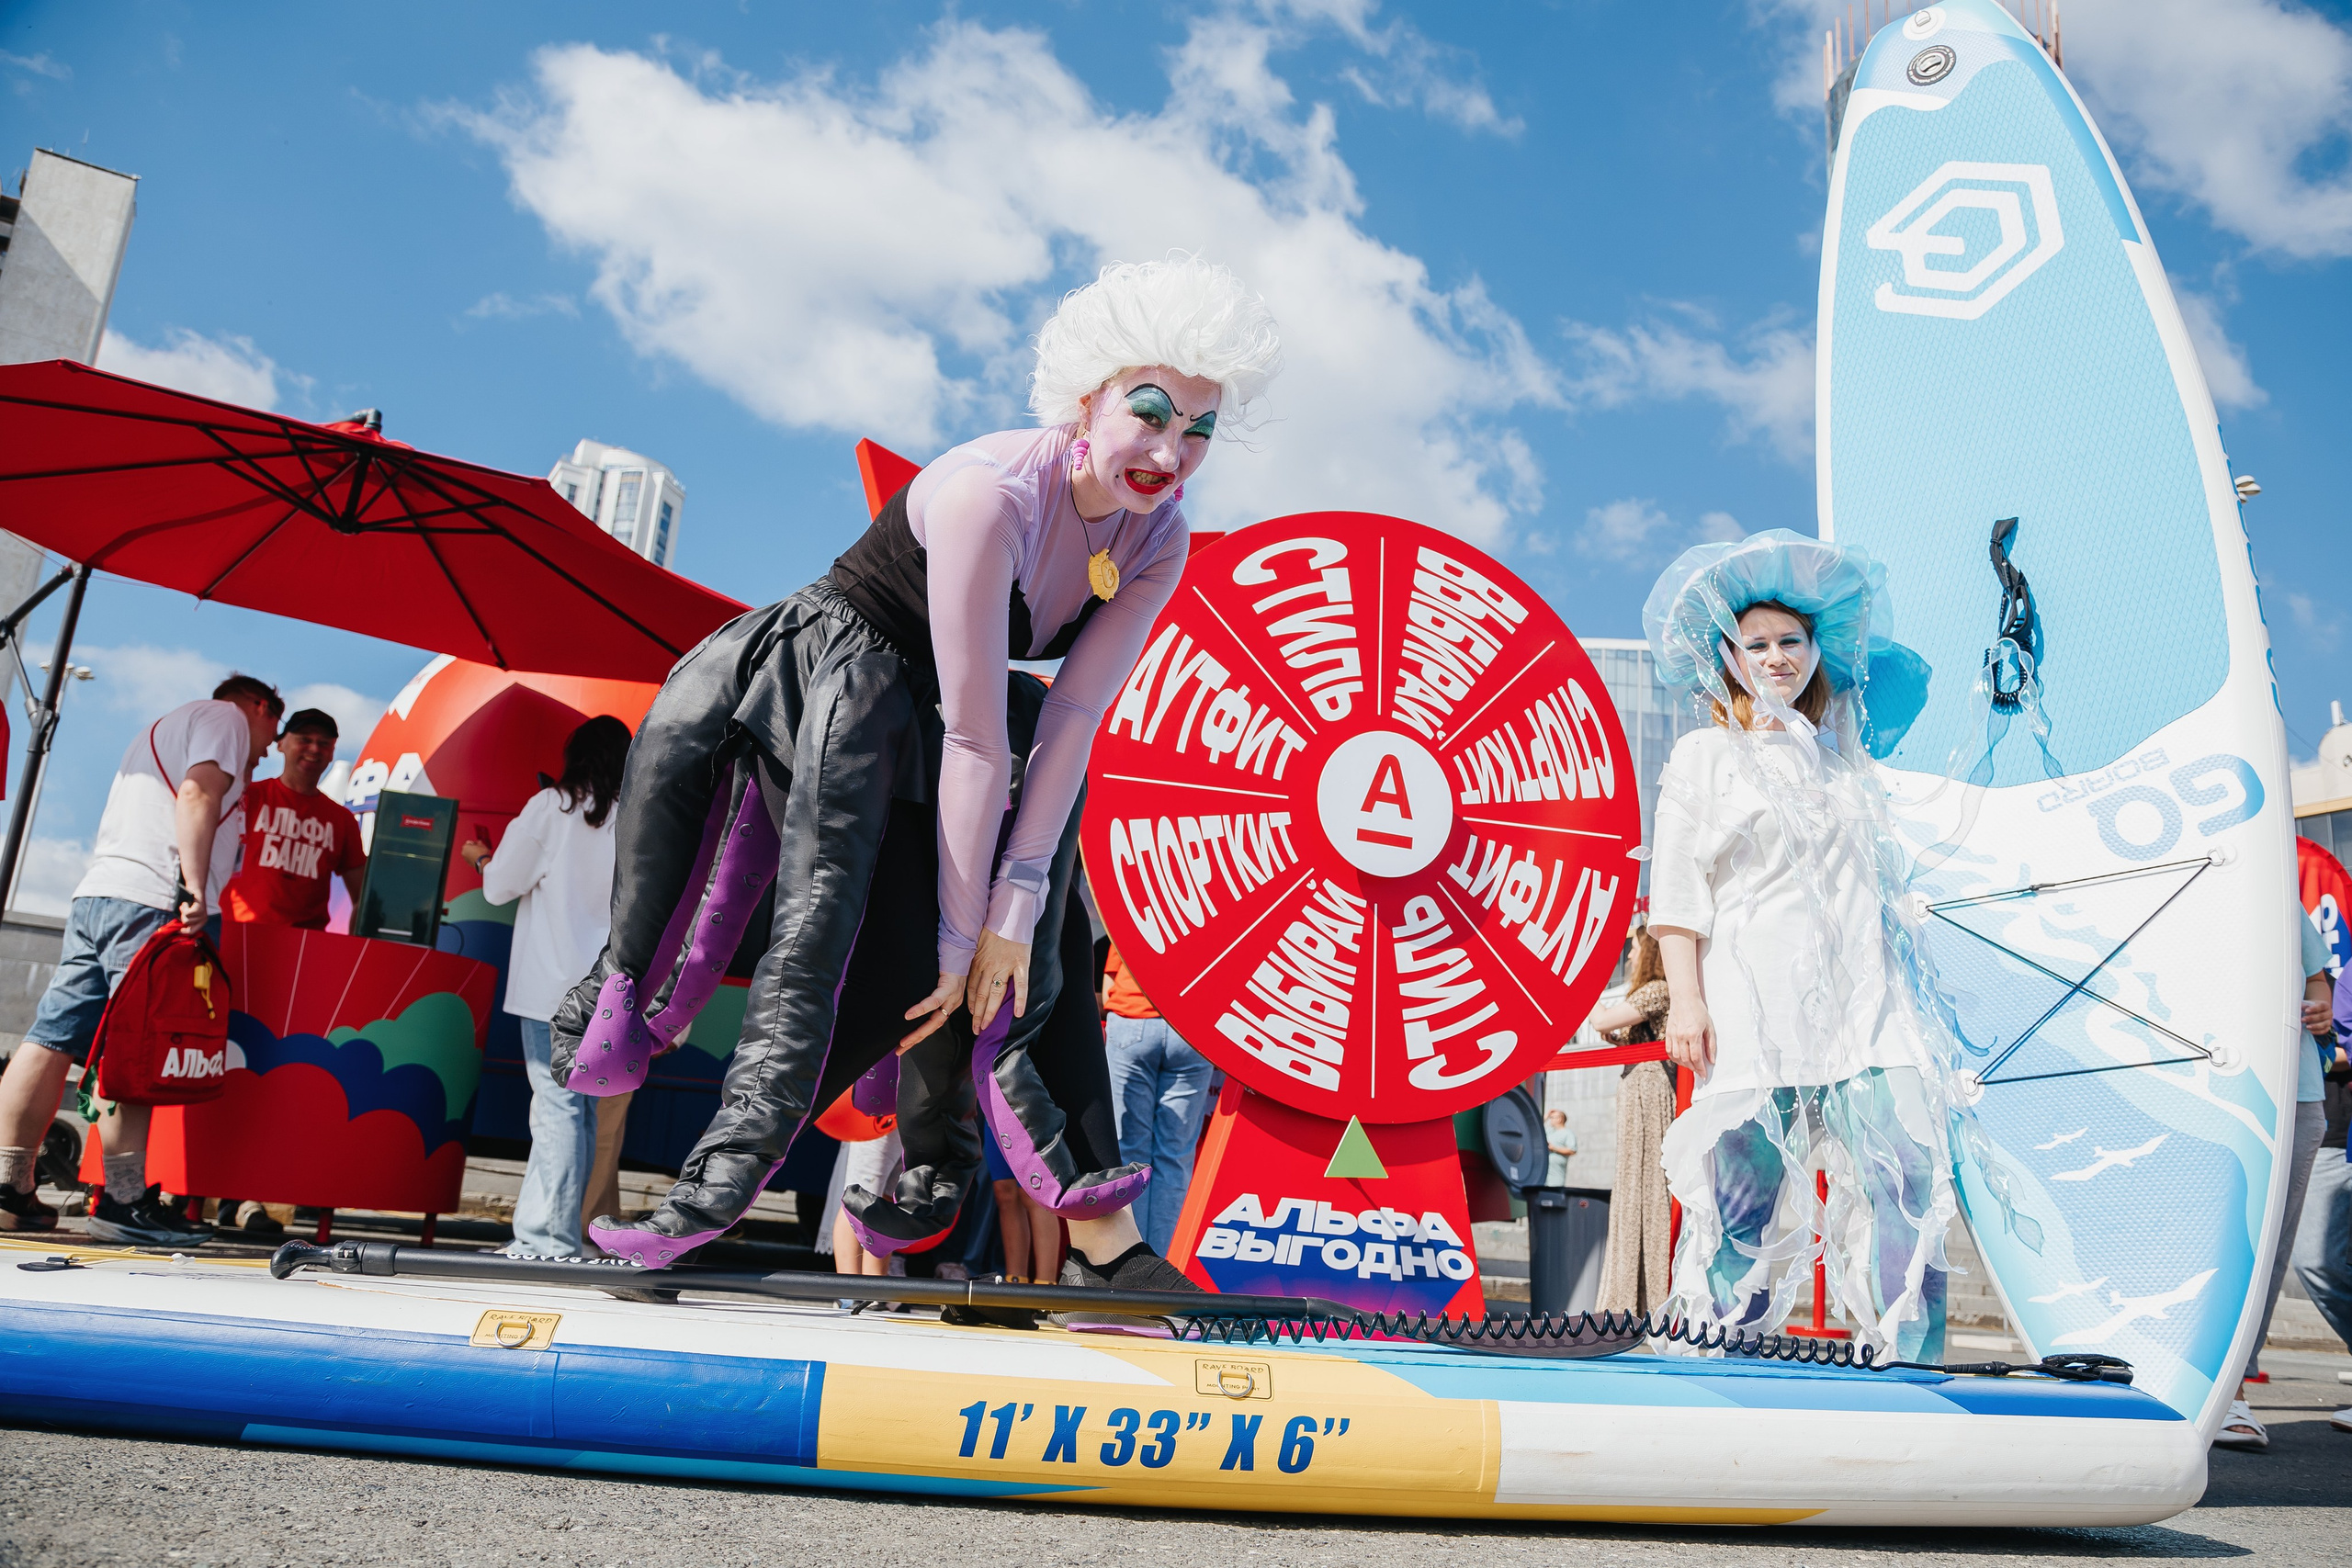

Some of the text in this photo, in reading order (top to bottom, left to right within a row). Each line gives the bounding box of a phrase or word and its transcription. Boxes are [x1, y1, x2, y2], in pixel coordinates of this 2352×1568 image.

[1232, 536, 1364, 722] СТИЛЬ
[1391, 545, 1530, 741] ВЫБИРАЙ
[1108, 622, 1307, 782] АУТФИТ
[1453, 677, 1615, 805] СПОРТКИТ
[253, 804, 334, 852] АЛЬФА
[2037, 747, 2170, 813] BOARD
[258, 834, 322, 880] БАНК
[1109, 811, 1299, 955] СПОРТКИТ
[1446, 834, 1619, 987] АУТФИТ
[1214, 877, 1367, 1092] ВЫБИРАЙ
[1391, 894, 1518, 1091] СТИЛЬ
[1195, 1226, 1474, 1282] ВЫГОДНО
[1212, 1192, 1466, 1247] АЛЬФА
[1041, 1405, 1087, 1463] X
[1219, 1414, 1263, 1472] X
